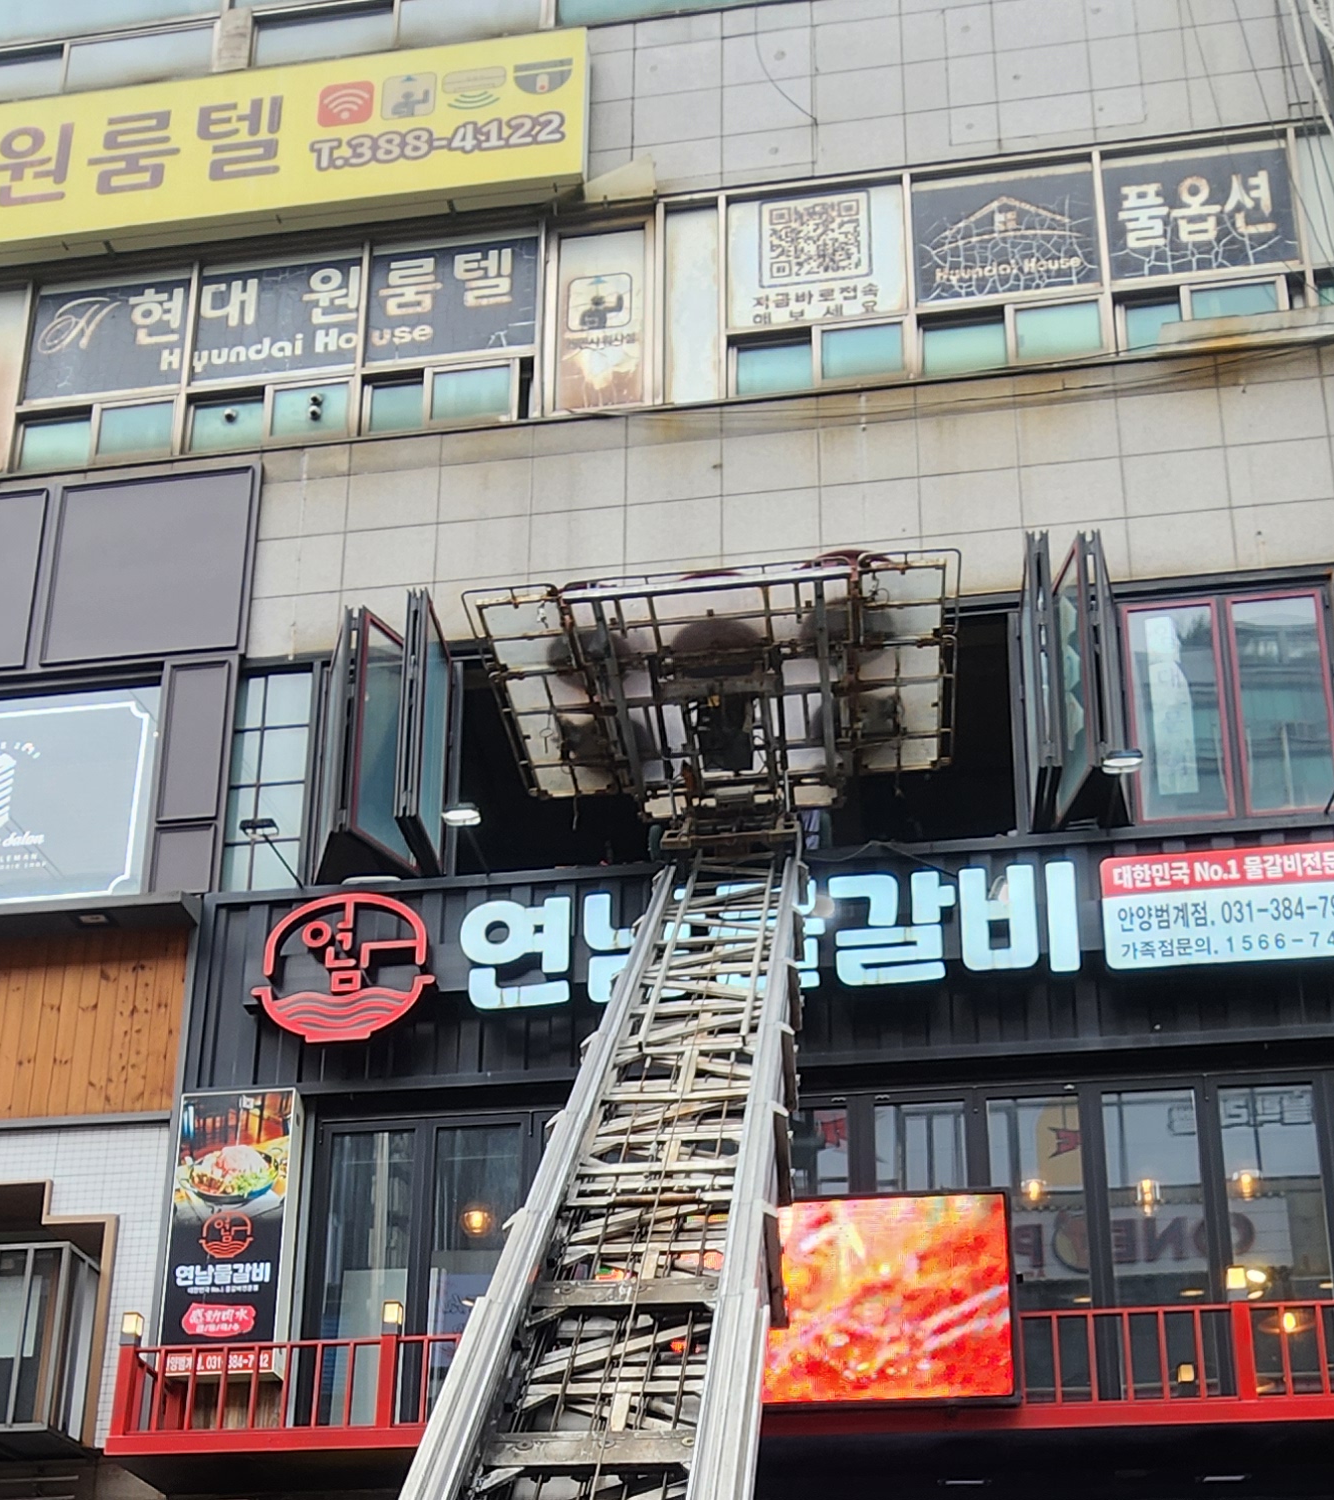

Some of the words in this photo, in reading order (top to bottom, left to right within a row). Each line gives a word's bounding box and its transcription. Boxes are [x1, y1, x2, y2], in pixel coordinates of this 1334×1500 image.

[309, 111, 566, 171] T.388-4122
[1119, 168, 1275, 249] 풀옵션
[935, 259, 1017, 285] Hyundai
[1023, 255, 1084, 273] House
[159, 332, 303, 375] Hyundai
[314, 320, 434, 357] House
[1113, 862, 1190, 889] 대한민국
[1195, 859, 1240, 881] No.1
[1117, 902, 1215, 933] 안양범계점.
[175, 1262, 271, 1286] 연남물갈비
